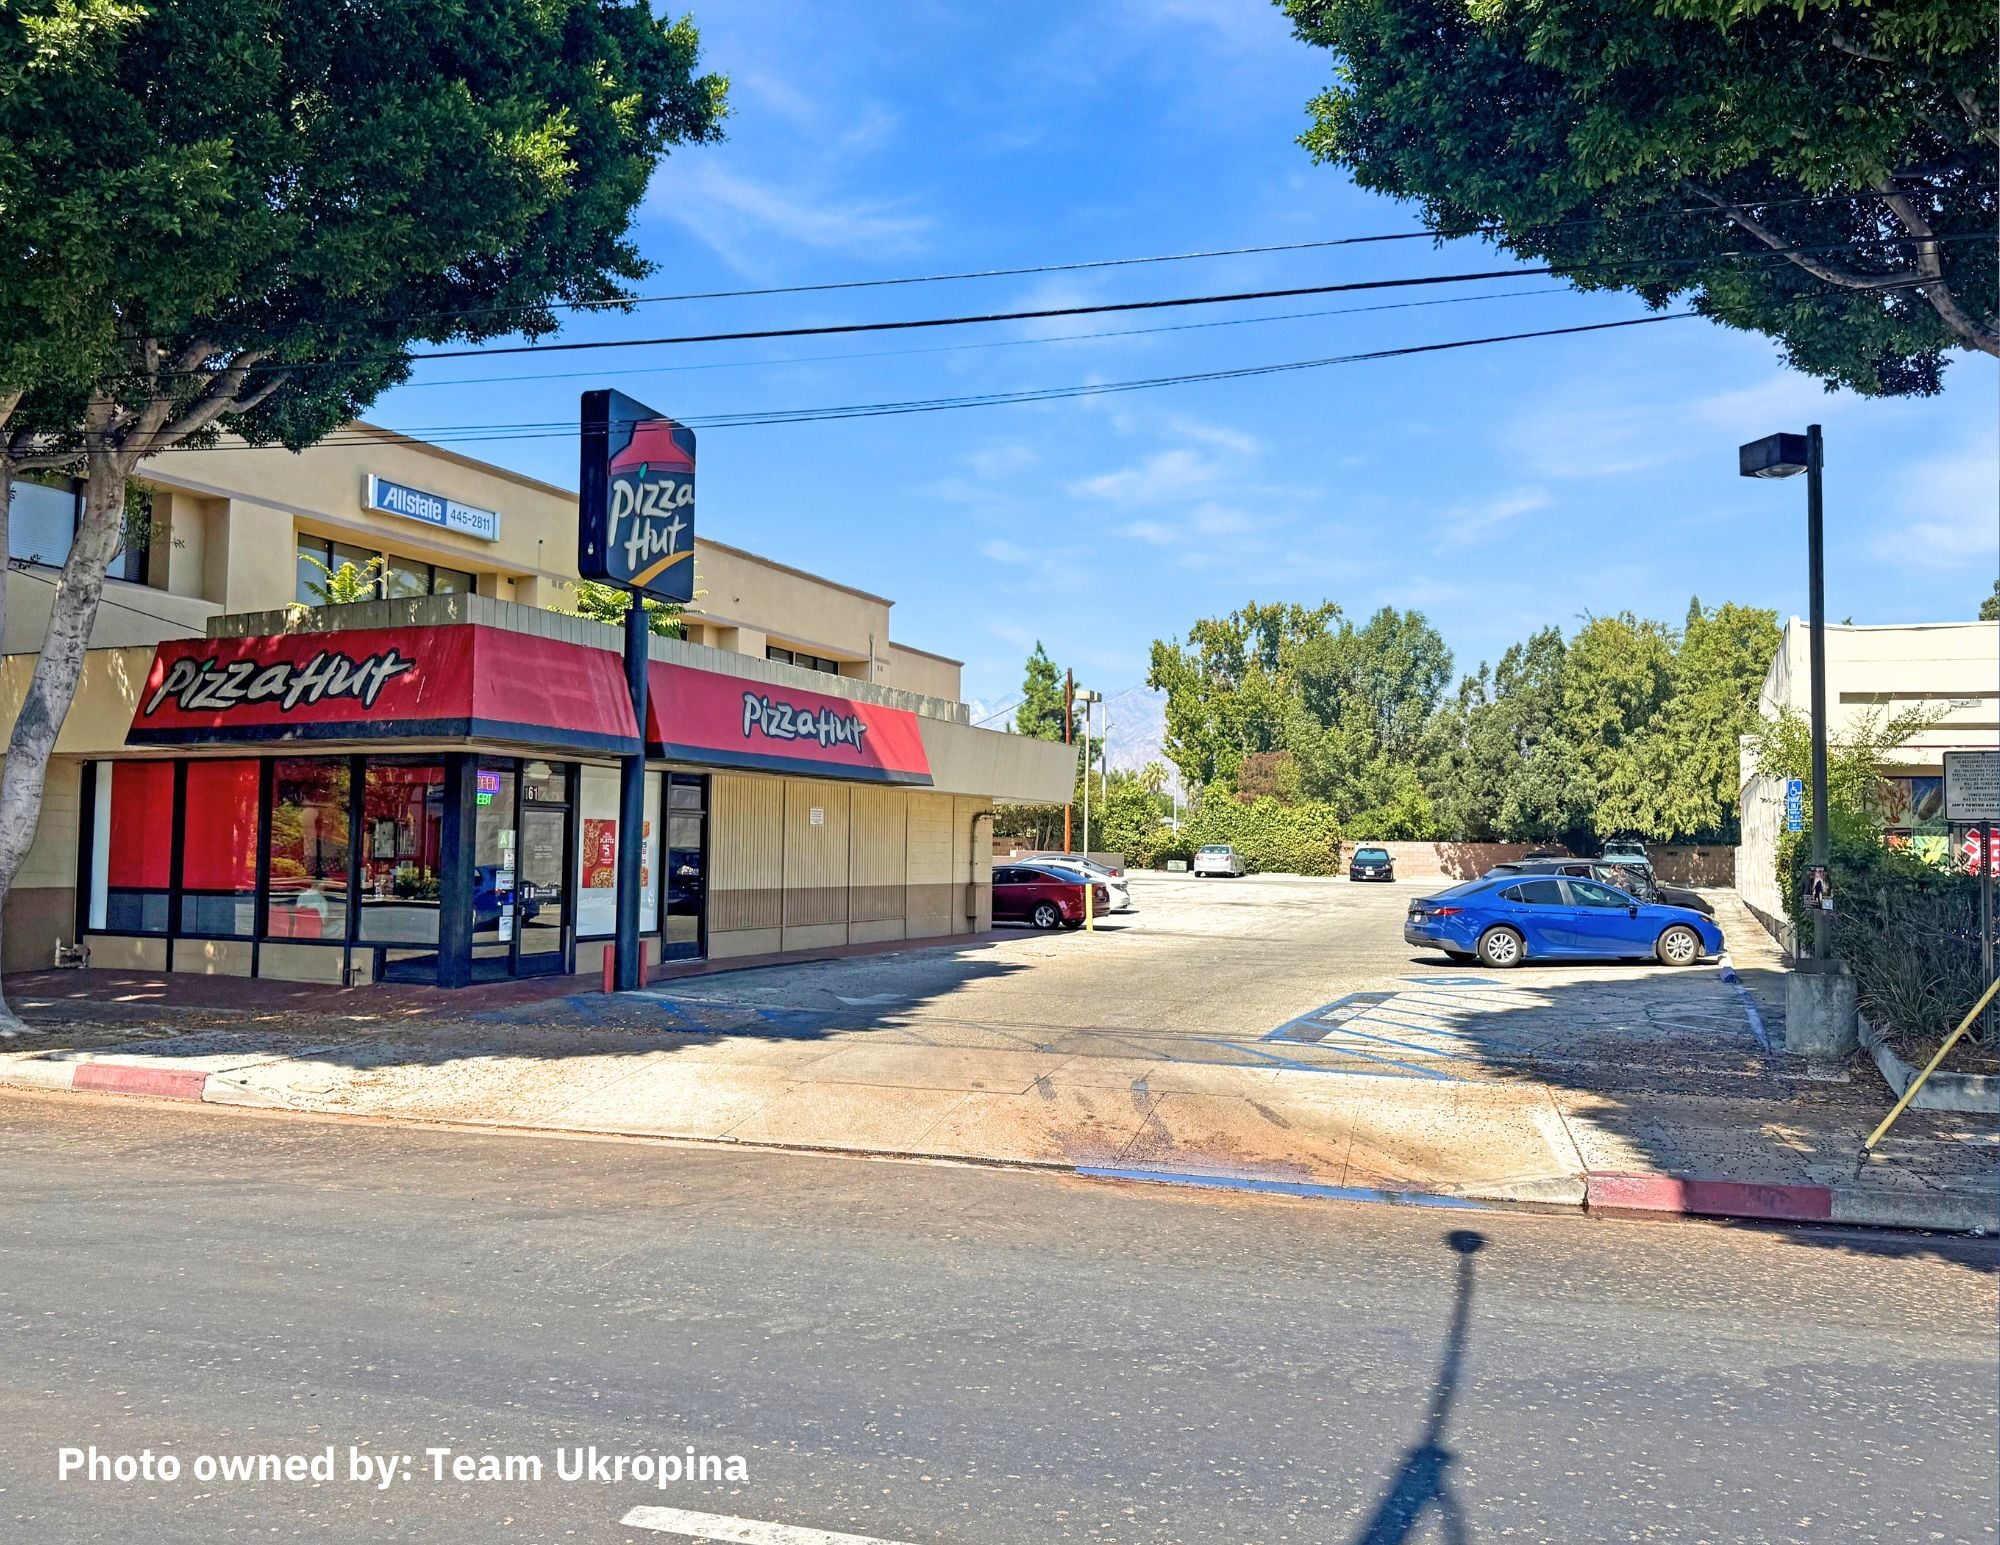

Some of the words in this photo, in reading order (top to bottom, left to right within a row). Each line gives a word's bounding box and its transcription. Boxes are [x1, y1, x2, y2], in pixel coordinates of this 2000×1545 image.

[383, 487, 442, 521] Allstate
[450, 508, 490, 531] 445-2811
[607, 463, 694, 547] Pizza
[624, 515, 687, 571] Hut
[146, 659, 292, 715] Pizza
[283, 652, 413, 709] Hut
[743, 694, 816, 738] Pizza
[815, 706, 867, 753] Hut
[500, 834, 508, 845] A
